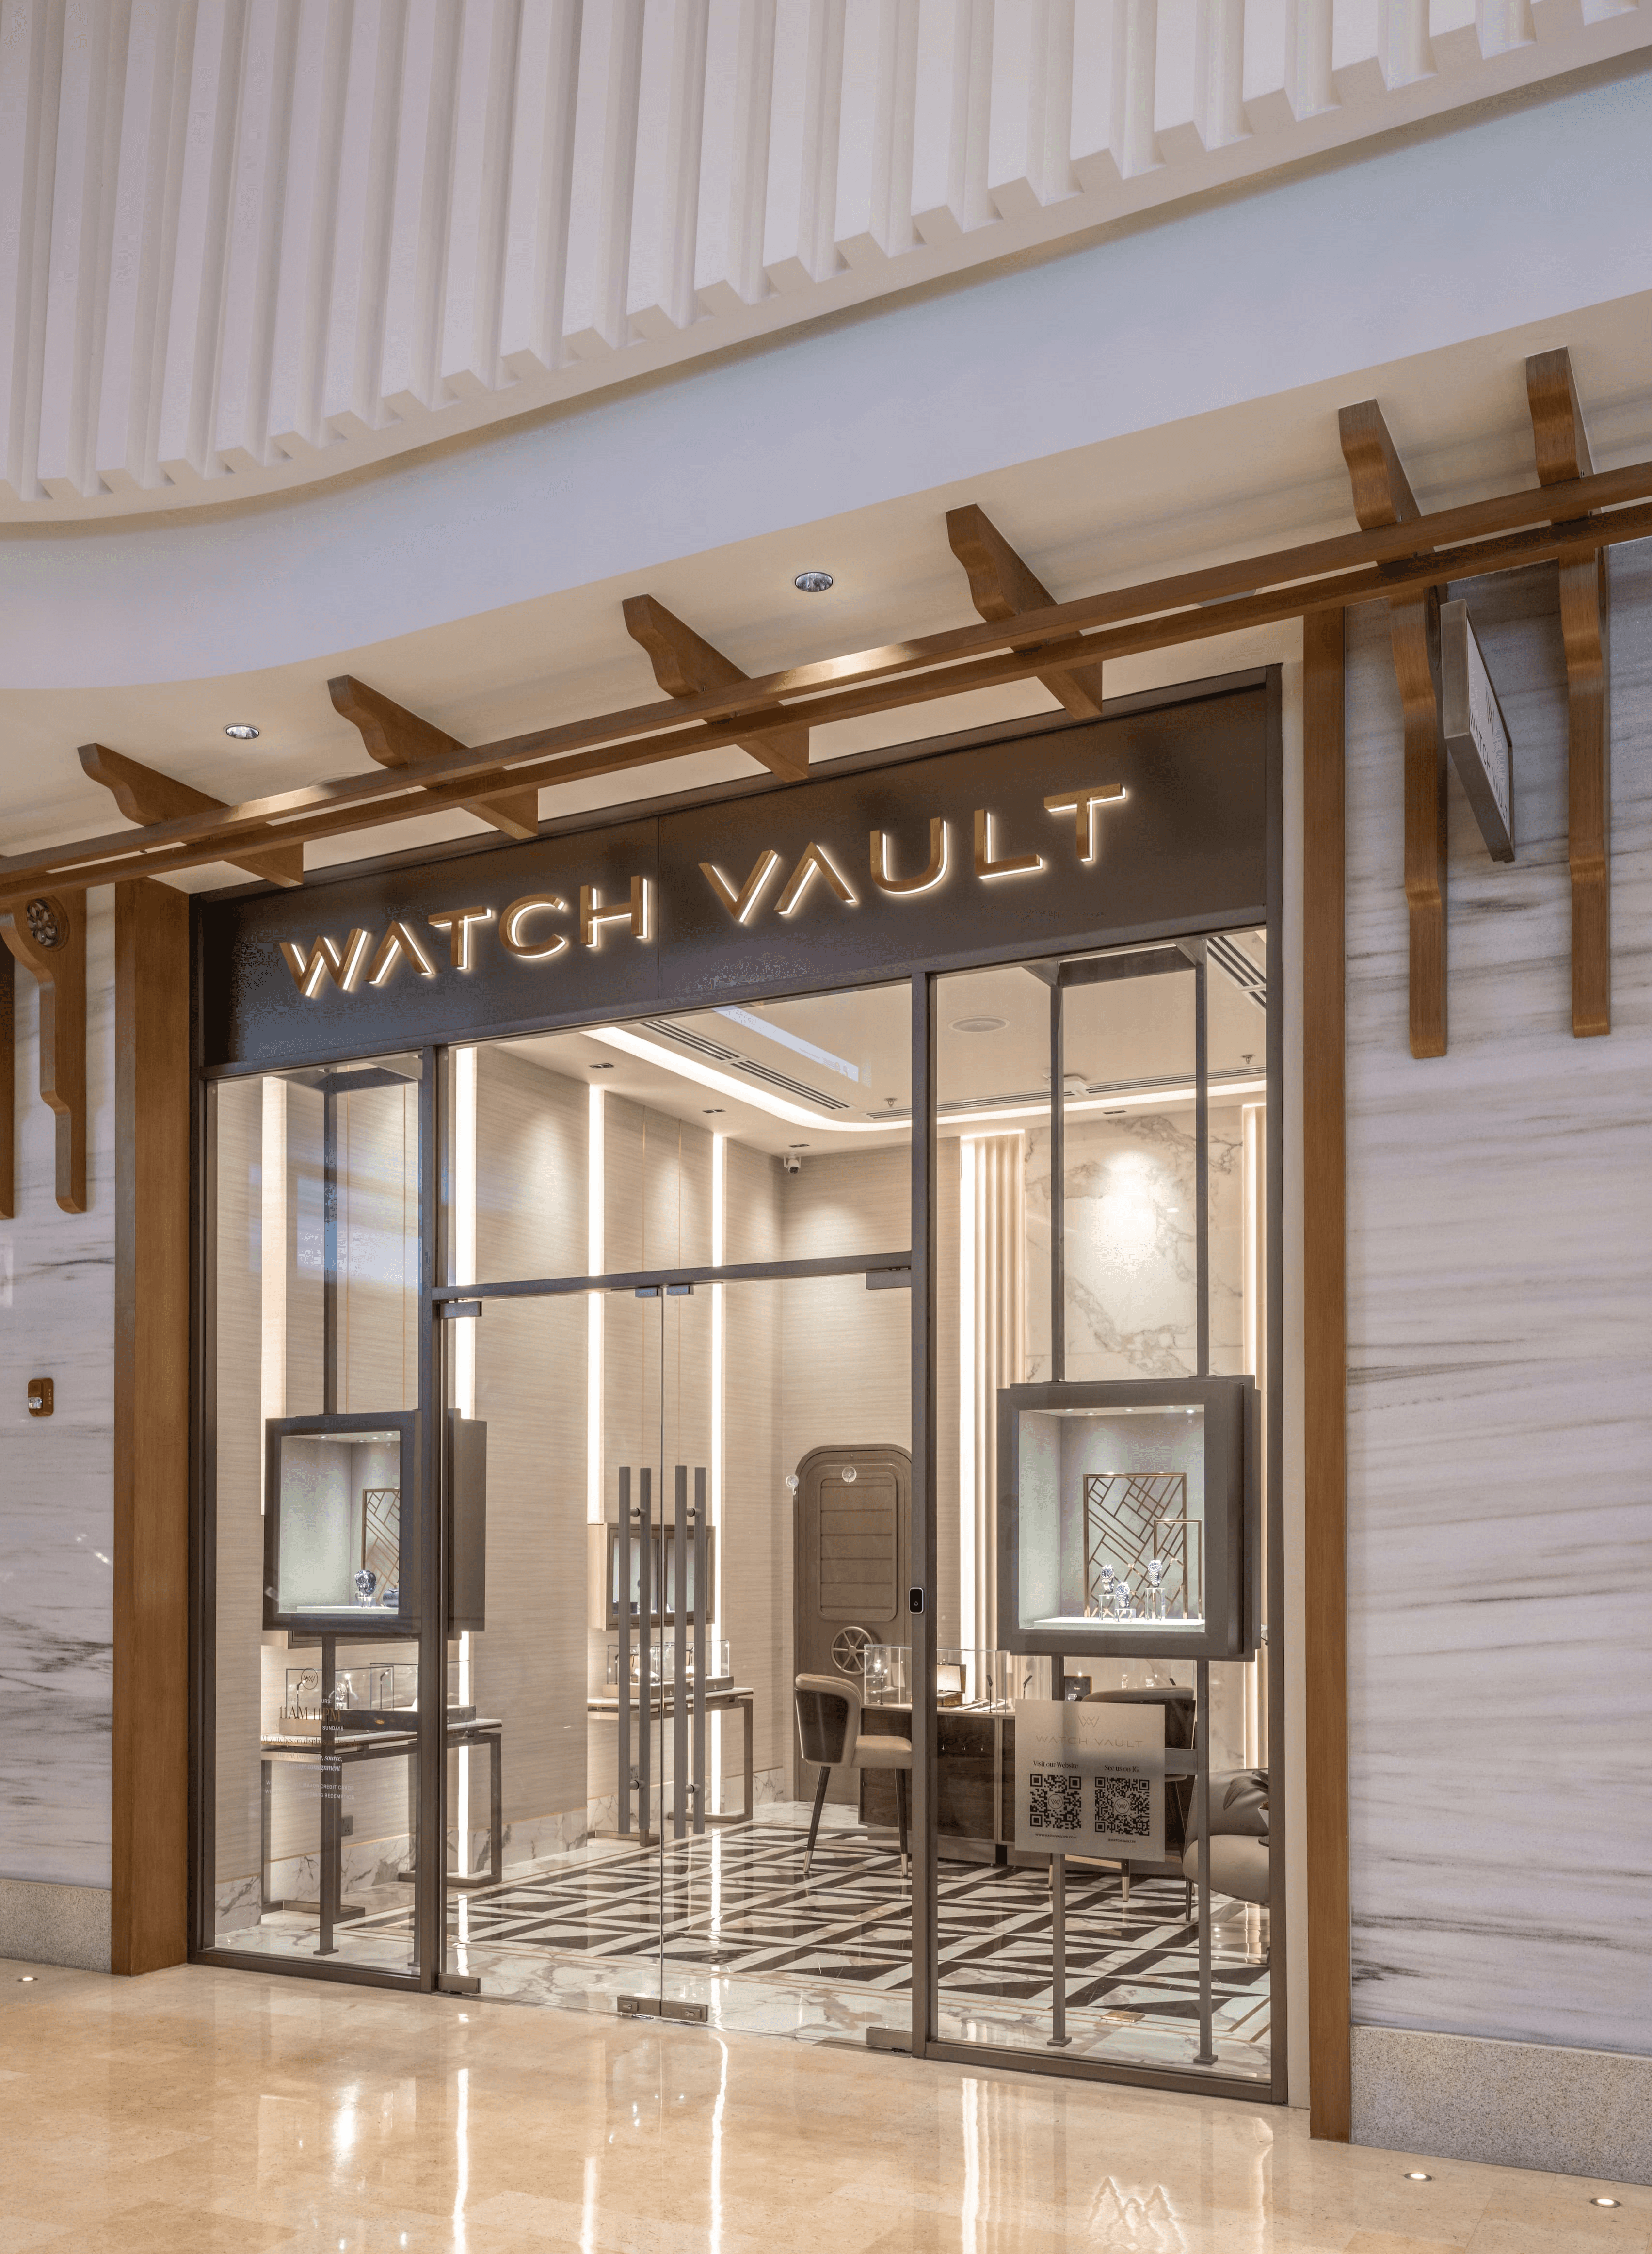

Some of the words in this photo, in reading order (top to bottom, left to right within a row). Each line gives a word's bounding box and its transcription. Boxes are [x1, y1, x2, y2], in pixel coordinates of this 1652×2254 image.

[1469, 704, 1491, 777] WATCH
[1492, 766, 1507, 824] VAULT
[278, 875, 650, 999] WATCH
[698, 783, 1127, 923] VAULT
[270, 1736, 293, 1744] watches
[1036, 1735, 1088, 1745] WATCH
[1094, 1738, 1144, 1748] VAULT
[307, 1763, 341, 1772] consignment
